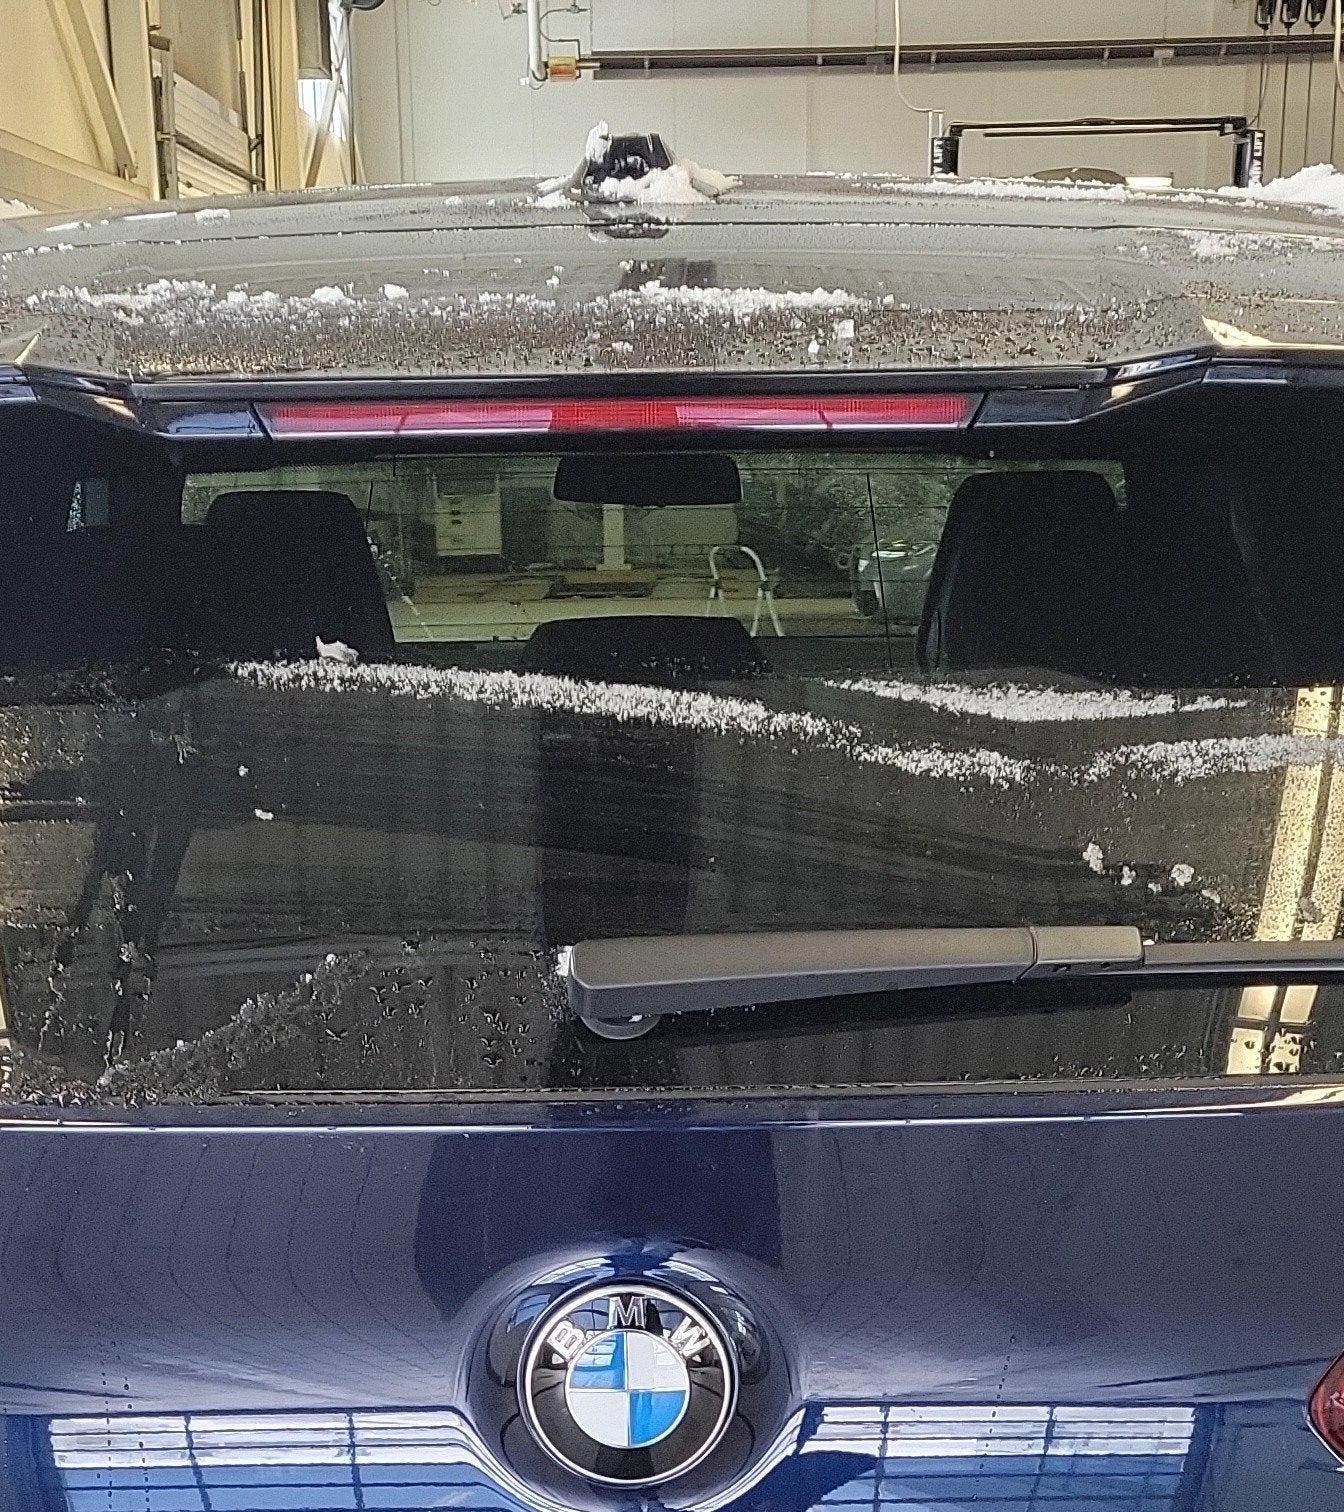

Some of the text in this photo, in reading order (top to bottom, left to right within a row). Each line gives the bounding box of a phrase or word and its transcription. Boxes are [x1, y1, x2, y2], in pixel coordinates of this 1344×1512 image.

[933, 139, 943, 164] LIFT
[1253, 131, 1264, 157] LIFT
[546, 1296, 711, 1360] BMW
